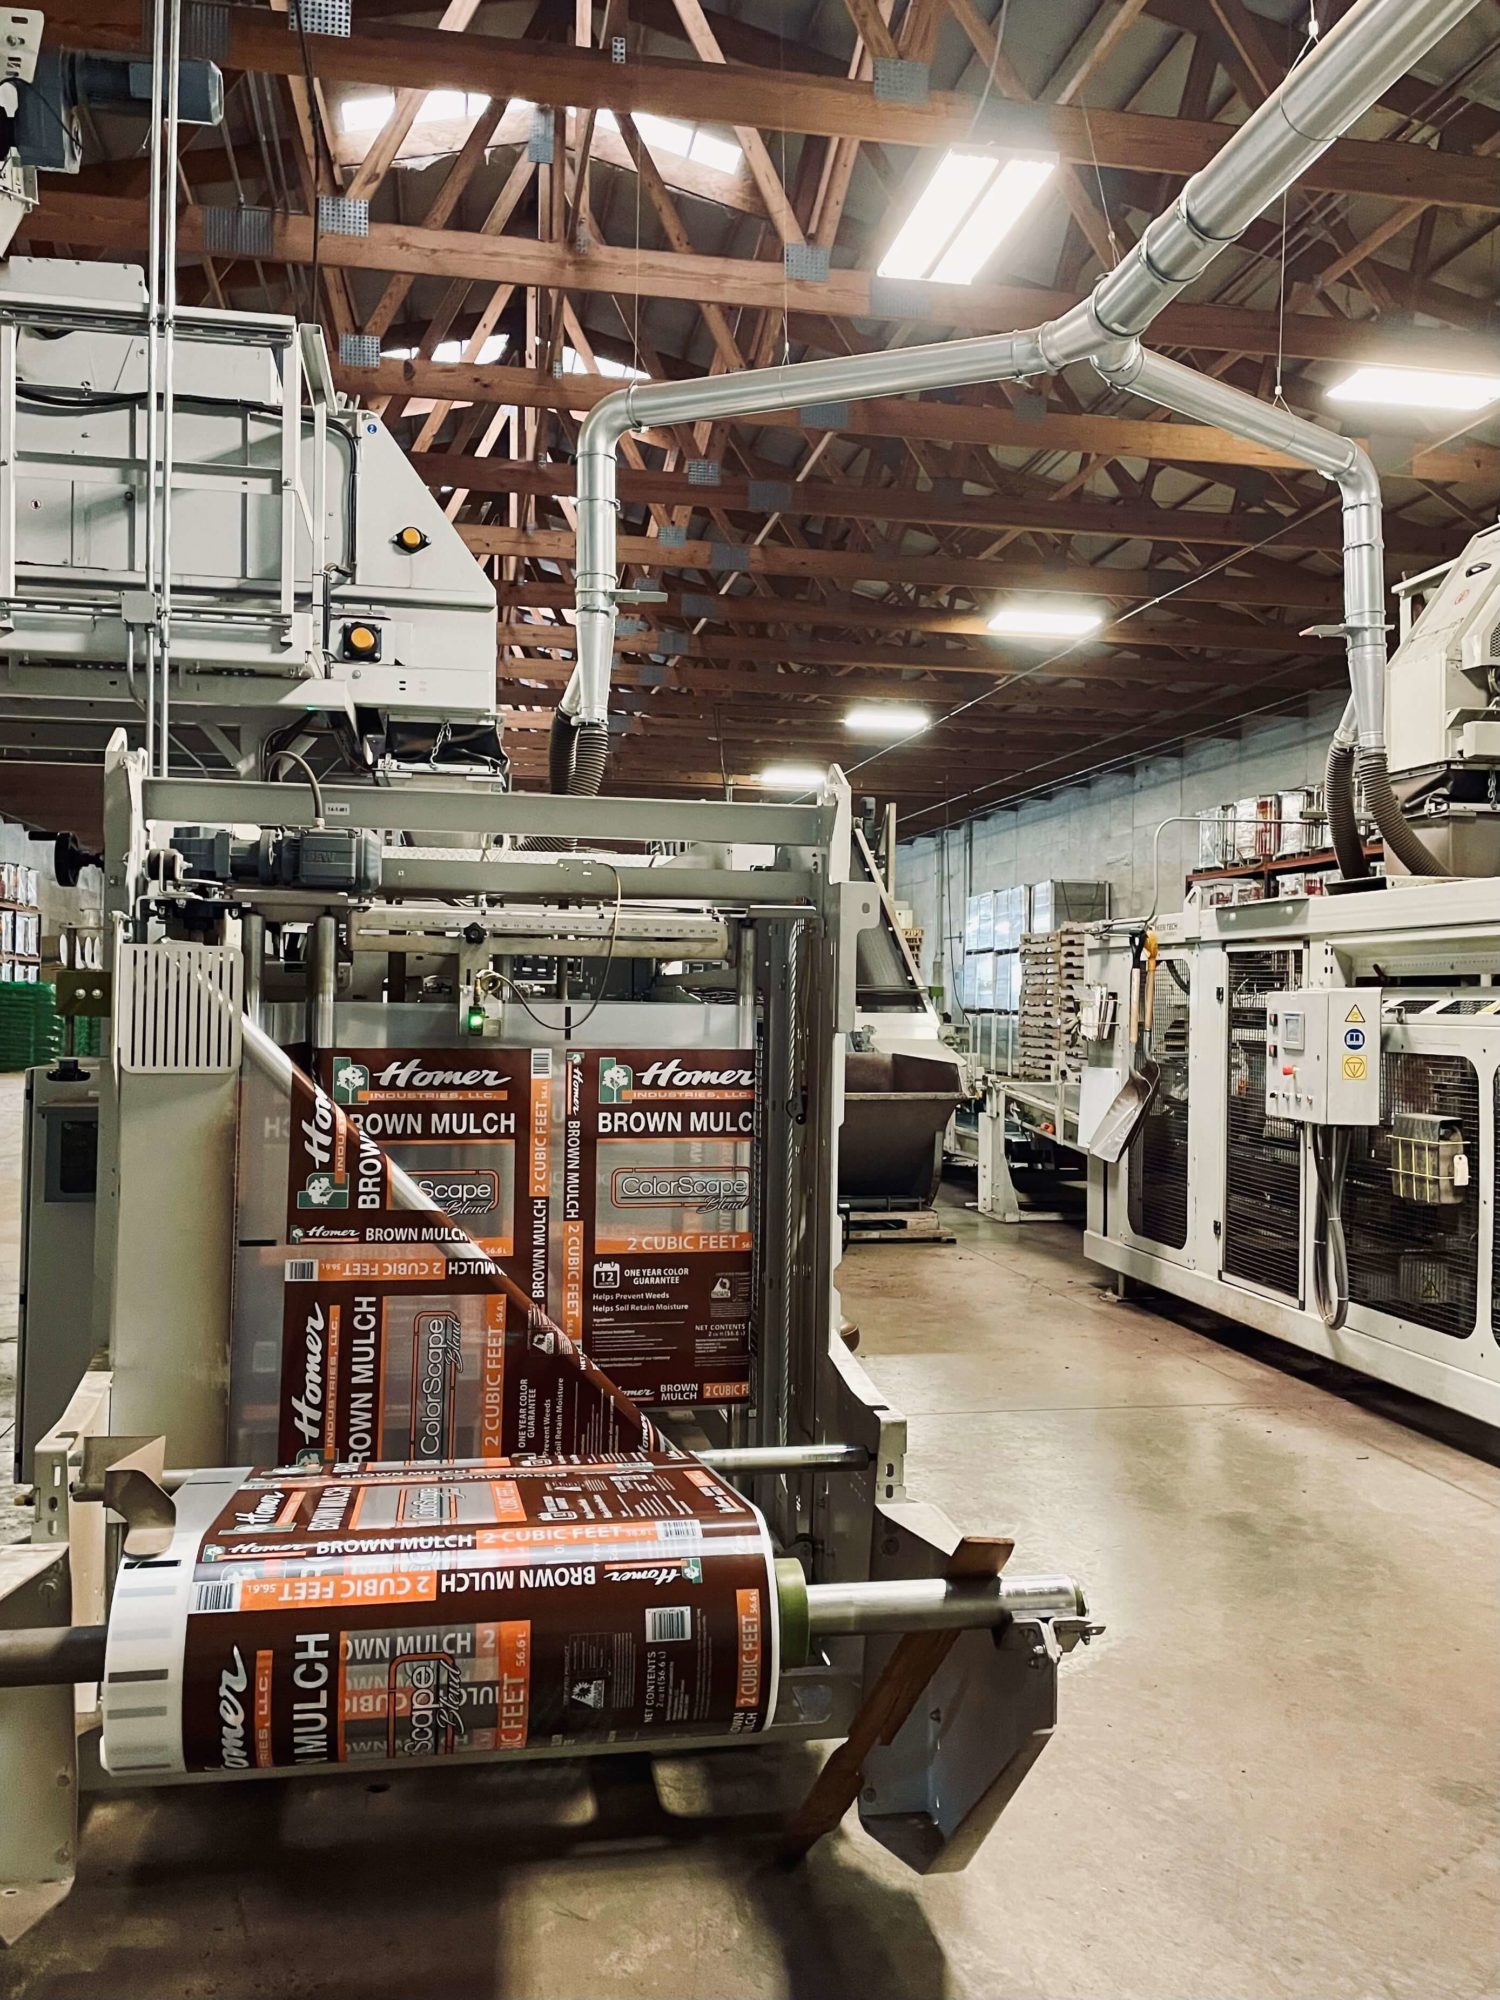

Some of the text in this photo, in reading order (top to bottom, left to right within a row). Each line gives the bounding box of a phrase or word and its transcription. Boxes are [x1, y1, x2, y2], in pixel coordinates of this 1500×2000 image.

[373, 1059, 512, 1088] Homer
[636, 1059, 755, 1087] Homer
[572, 1067, 584, 1115] Homer
[349, 1112, 515, 1134] ROWN MULCH
[535, 1101, 548, 1134] FEET
[598, 1111, 753, 1133] BROWN MULC
[567, 1121, 580, 1168] BROWN
[358, 1131, 381, 1209] BROW
[535, 1138, 547, 1182] CUBIC
[417, 1180, 491, 1202] Scape
[535, 1185, 546, 1193] 2
[566, 1174, 580, 1219] MULCH
[621, 1176, 748, 1199] ColorScape
[696, 1195, 749, 1214] Blend
[306, 1225, 470, 1241] Homer BROWN MULCH
[533, 1200, 547, 1246] MULCH
[568, 1225, 579, 1233] 2
[627, 1238, 638, 1251] 2
[642, 1236, 694, 1250] CUBIC
[699, 1235, 739, 1249] FEET
[342, 1262, 379, 1276] FEET
[383, 1262, 429, 1275] CUBIC
[432, 1261, 442, 1275] 2
[568, 1237, 580, 1280] CUBIC
[532, 1250, 545, 1298] BROWN
[601, 1272, 613, 1282] 12
[624, 1269, 640, 1277] ONE
[663, 1268, 689, 1276] COLOR
[633, 1276, 680, 1285] GUARANTEE
[567, 1283, 580, 1317] FEET
[593, 1293, 614, 1302] Helps
[645, 1291, 669, 1299] Weeds
[593, 1305, 614, 1313] Helps
[656, 1303, 689, 1311] Moisture
[487, 1326, 502, 1369] FEET
[291, 1301, 325, 1445] Homer
[348, 1296, 377, 1463] ROWN MULCH
[421, 1318, 444, 1455] ColorScape
[556, 1378, 564, 1413] Moisture
[660, 1383, 698, 1393] BROWN
[661, 1392, 697, 1401] MULCH
[706, 1386, 711, 1397] 2
[713, 1384, 740, 1396] CUBIC
[485, 1375, 501, 1431] CUBIC
[518, 1379, 528, 1448] ONE YEAR COLOR
[527, 1388, 537, 1438] GUARANTEE
[543, 1399, 551, 1425] Weeds
[555, 1414, 563, 1439] Retain
[485, 1436, 499, 1447] 2
[316, 1535, 395, 1555] BROWN
[401, 1534, 473, 1550] MULCH
[482, 1533, 495, 1544] 2
[502, 1529, 568, 1541] CUBIC
[572, 1526, 622, 1539] FEET
[278, 1580, 335, 1601] FEET
[340, 1577, 412, 1598] CUBIC
[416, 1575, 430, 1592] 2
[440, 1565, 681, 1593] Homer BROWN MULCH
[396, 1632, 472, 1656] MULCH
[482, 1629, 496, 1649] 2
[742, 1615, 759, 1652] FEET
[645, 1651, 656, 1706] CONTENTS
[741, 1654, 758, 1696] CUBIC
[205, 1644, 250, 1770] omer
[293, 1633, 330, 1754] MULCH
[502, 1672, 525, 1730] FEET
[741, 1697, 756, 1705] 2
